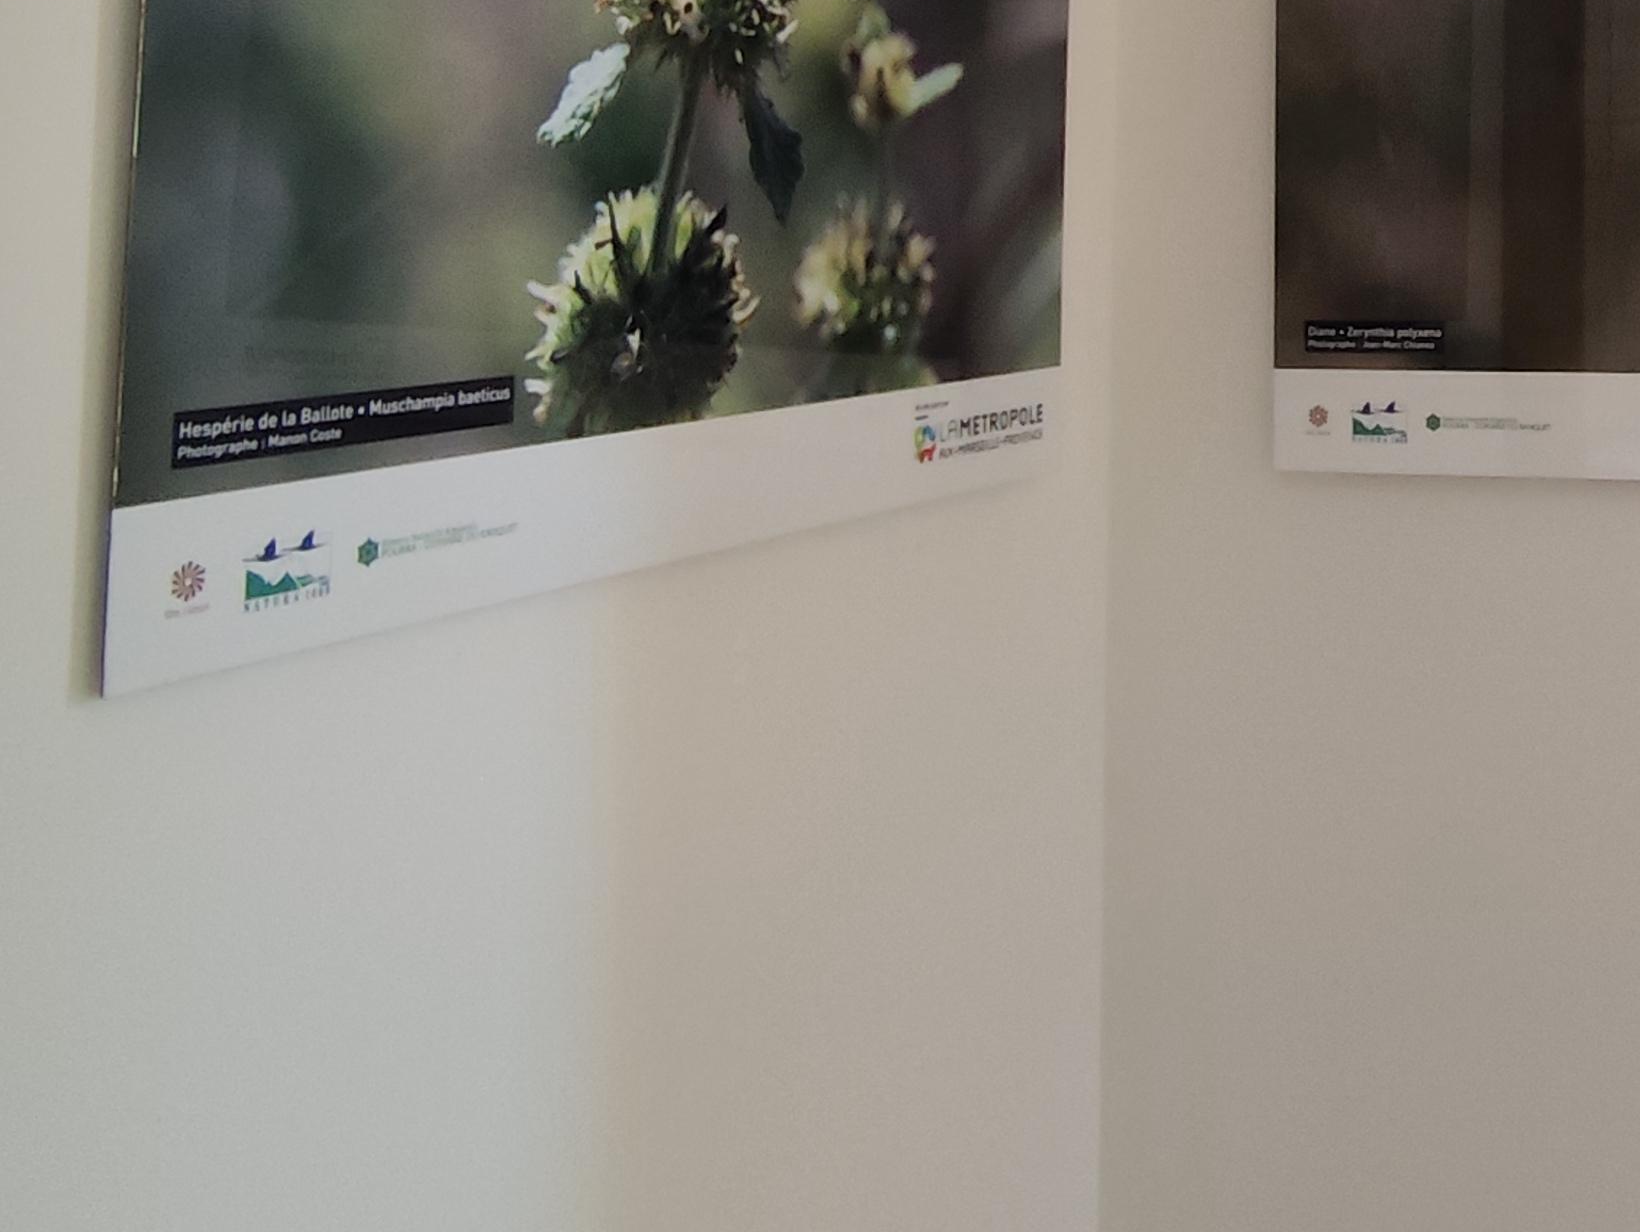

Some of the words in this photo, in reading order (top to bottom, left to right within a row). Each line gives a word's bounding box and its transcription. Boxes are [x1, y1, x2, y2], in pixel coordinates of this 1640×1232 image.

[179, 415, 255, 440] Hespérie
[258, 412, 278, 430] de
[281, 410, 297, 428] la
[300, 404, 354, 425] Ballote
[368, 391, 456, 417] Muschampia
[457, 386, 511, 407] baeticus
[176, 439, 259, 460] Photographe
[309, 427, 343, 443] Coste
